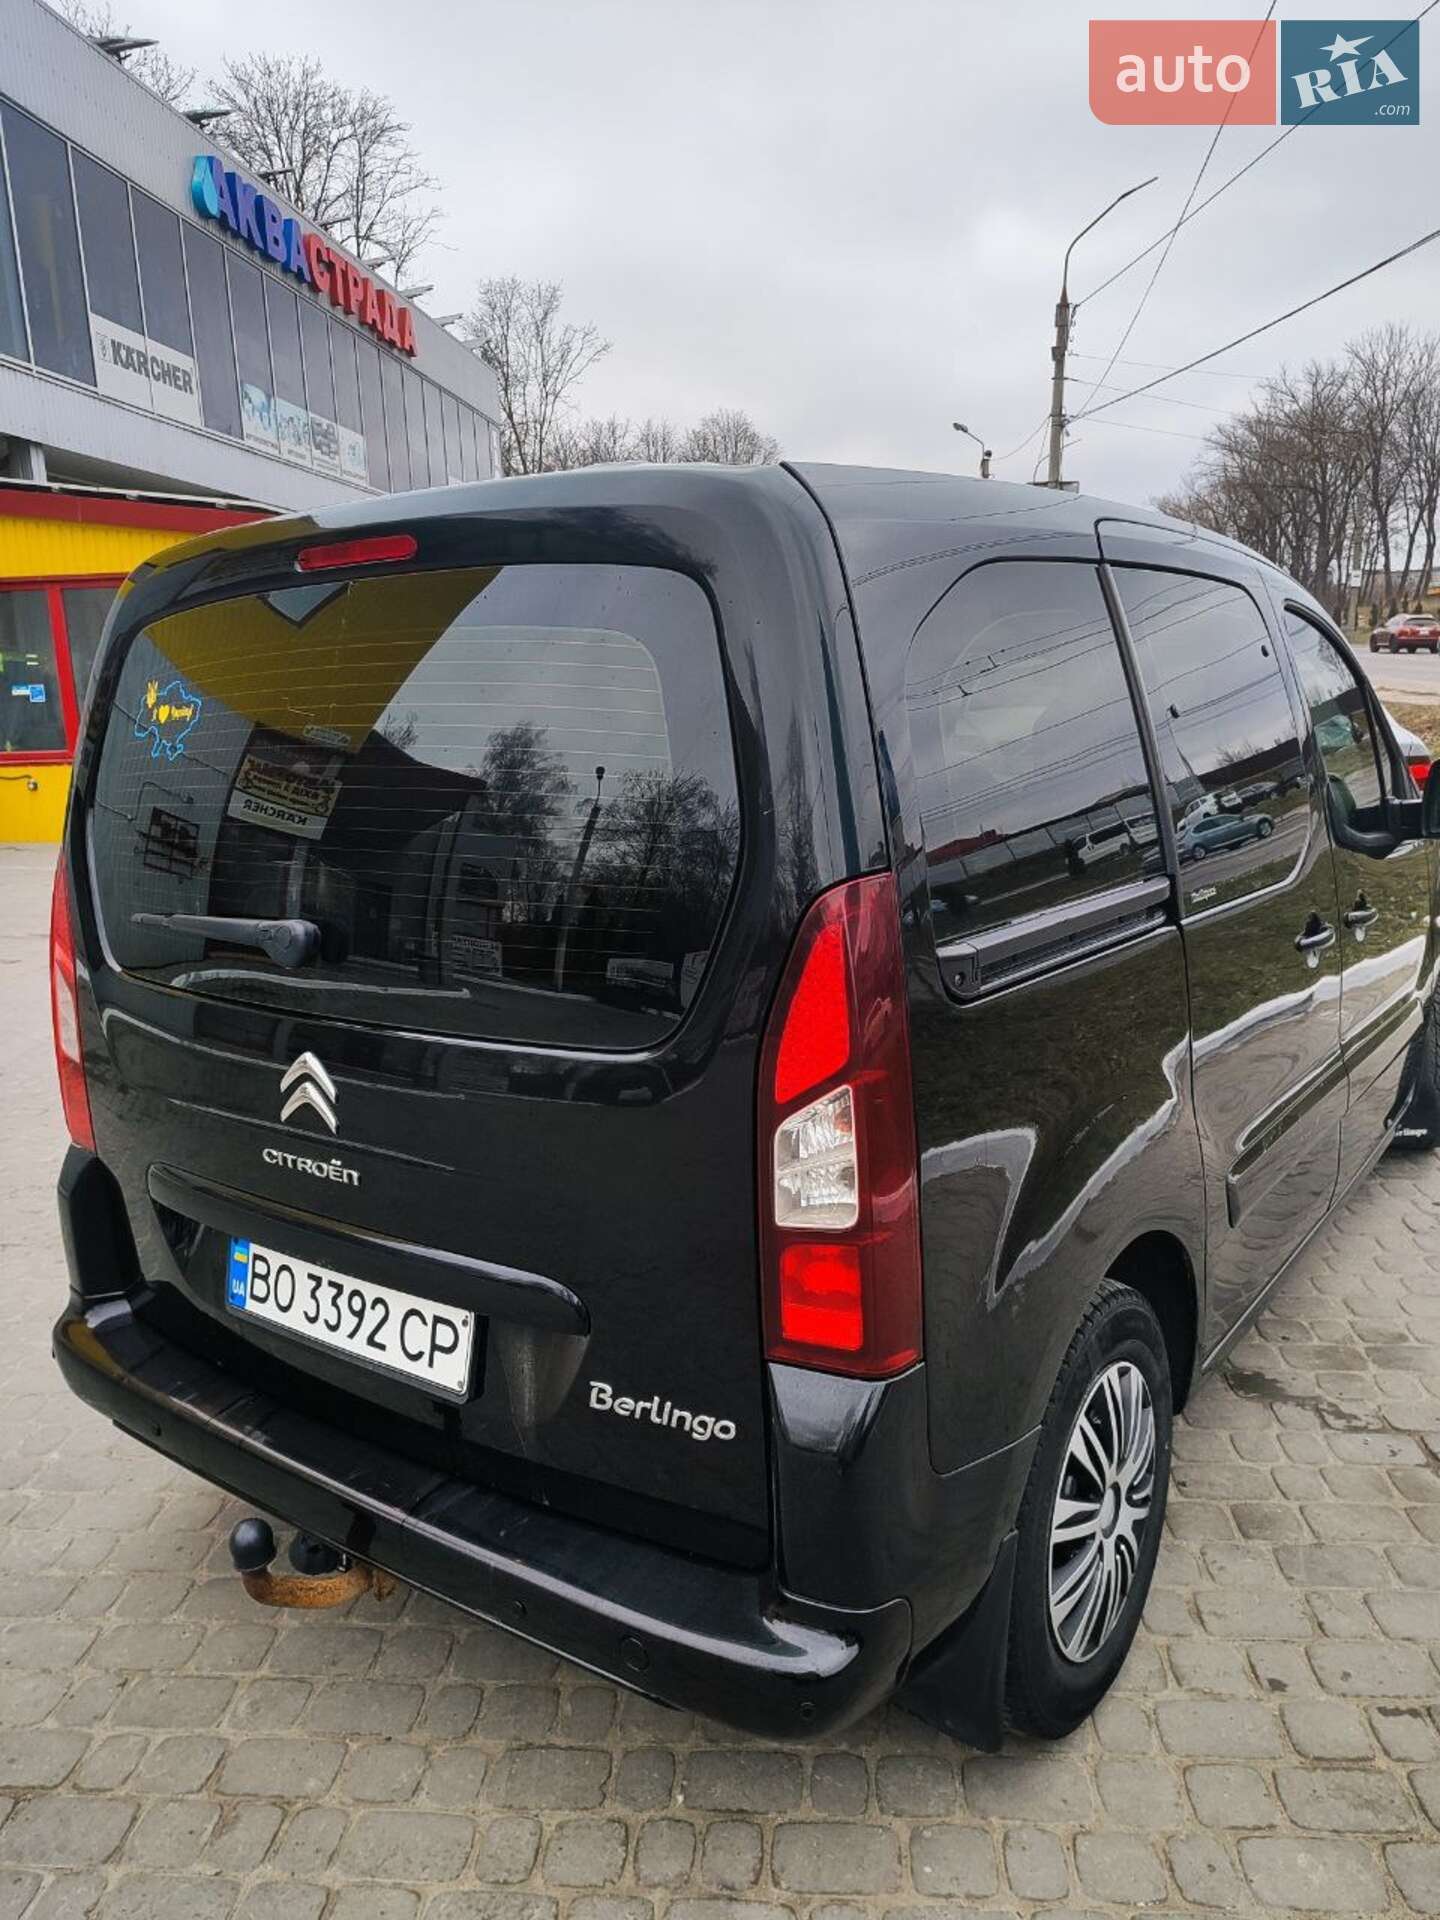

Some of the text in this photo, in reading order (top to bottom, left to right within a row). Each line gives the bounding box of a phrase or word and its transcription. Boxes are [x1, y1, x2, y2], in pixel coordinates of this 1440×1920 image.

[232, 1280, 245, 1297] UA
[303, 1272, 390, 1352] 3392
[589, 1380, 736, 1441] Berlingo
